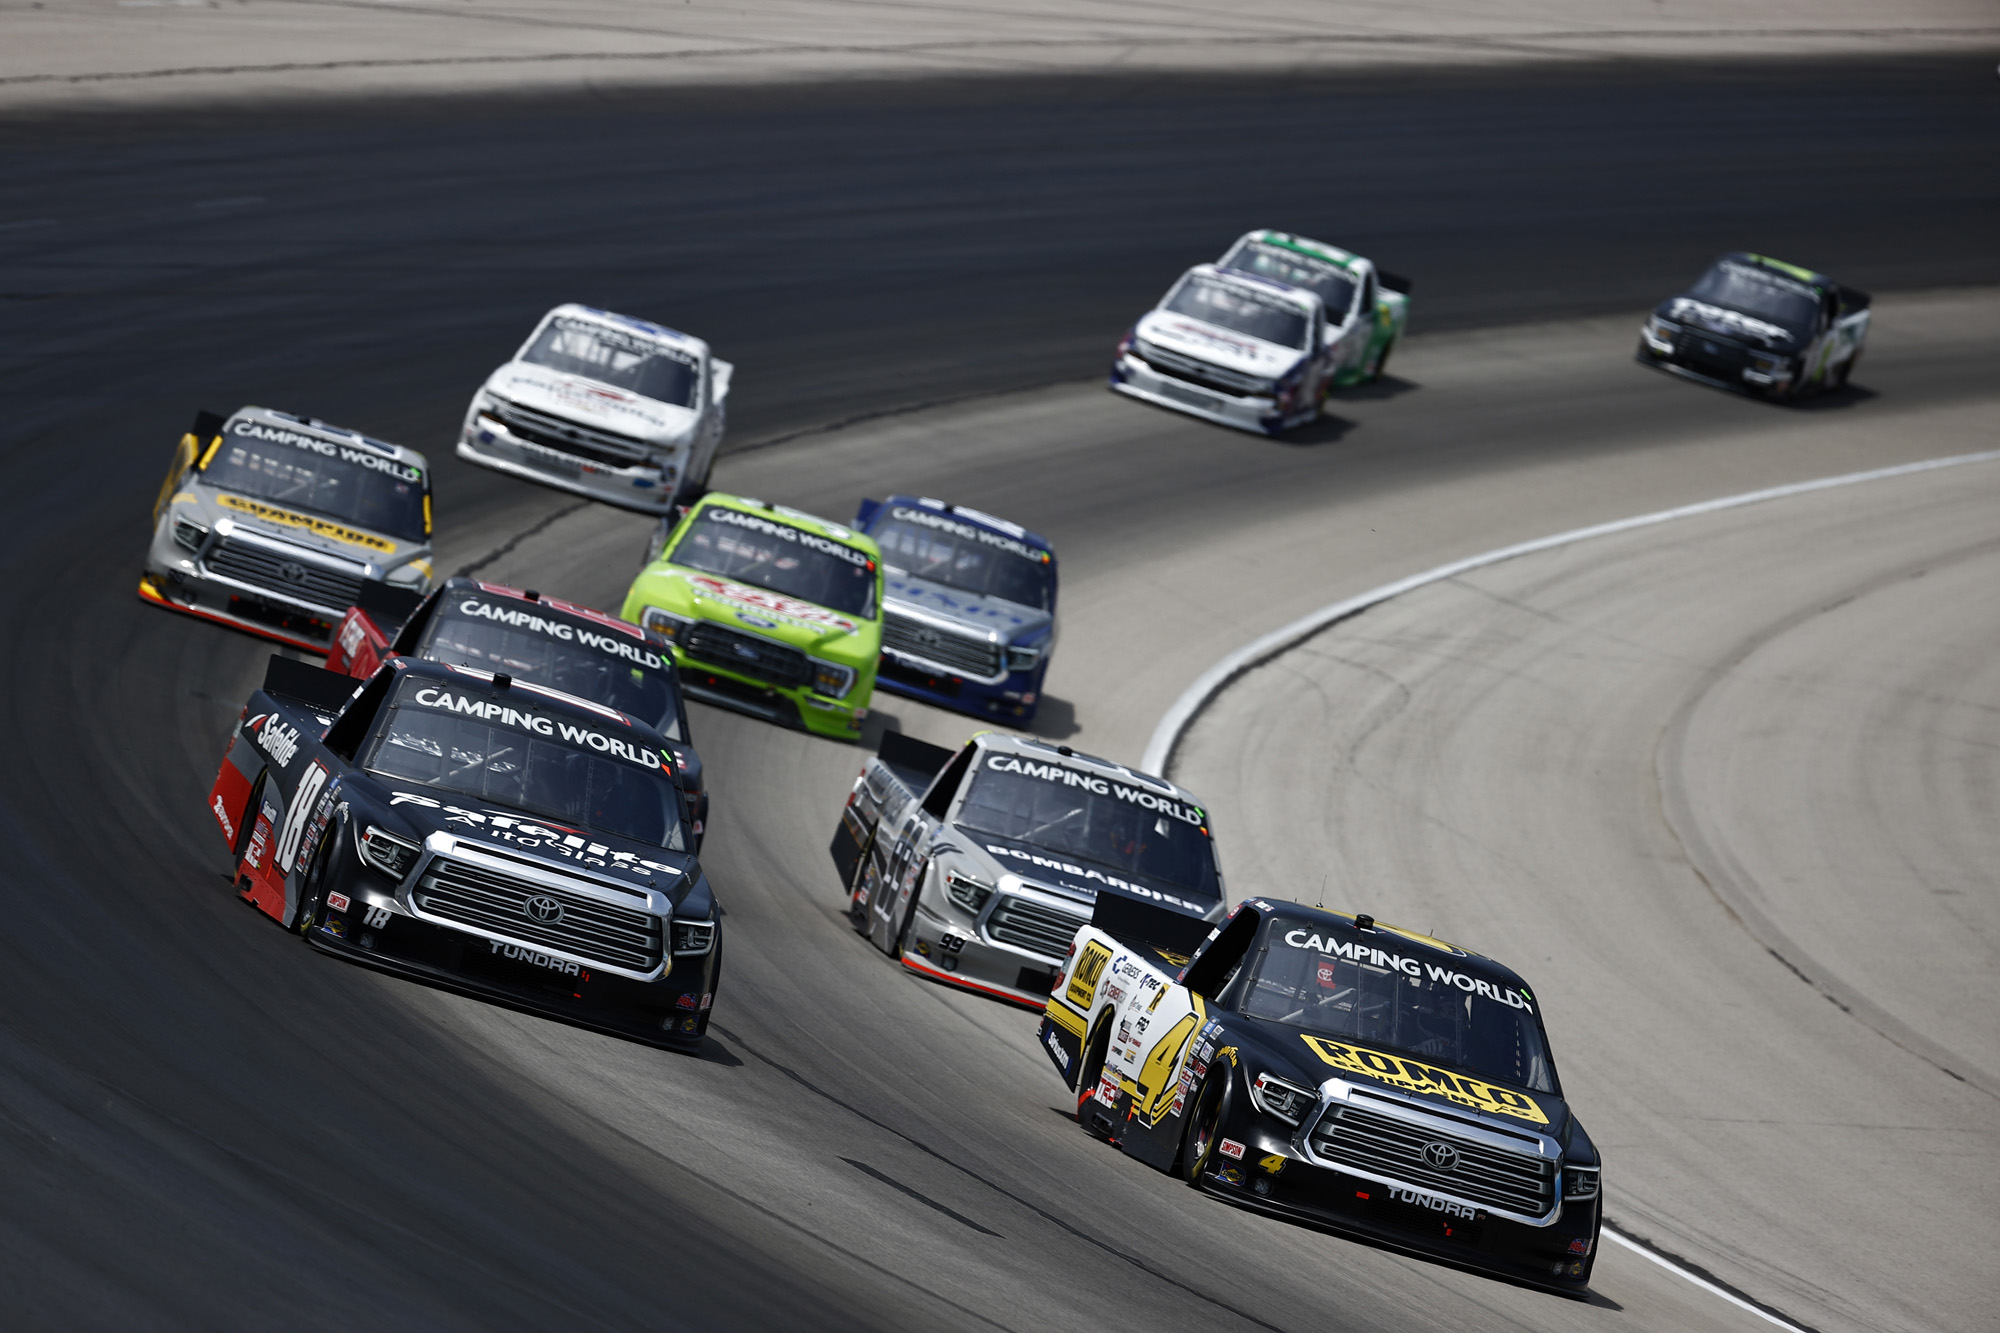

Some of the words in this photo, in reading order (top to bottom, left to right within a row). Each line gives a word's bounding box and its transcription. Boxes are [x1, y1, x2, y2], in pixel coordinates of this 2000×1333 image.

[233, 422, 337, 456] CAMPING
[340, 449, 418, 482] WORLD
[226, 496, 388, 549] CHAMPION
[708, 508, 798, 542] CAMPING
[799, 530, 867, 567] WORLD
[892, 507, 976, 540] CAMPING
[978, 530, 1043, 562] WORLD
[459, 600, 573, 641] CAMPING
[576, 627, 662, 670] WORLD
[257, 712, 301, 768] Safelite
[415, 688, 554, 737] CAMPING
[557, 721, 662, 770] WORLD
[987, 755, 1111, 796] CAMPING
[1113, 783, 1202, 826] WORLD
[389, 790, 683, 876] Safelite
[986, 844, 1206, 914] BOMBARDIER
[362, 905, 393, 930] 18
[938, 932, 966, 953] 99
[489, 940, 580, 977] TUNDRA
[1284, 929, 1421, 977] CAMPING
[1424, 962, 1524, 1010] WORLD
[1135, 1012, 1200, 1130] 4
[1313, 1037, 1533, 1111] ROMCO
[1221, 1141, 1243, 1157] SIMPSON
[1259, 1154, 1287, 1176] 4
[1387, 1185, 1477, 1222] TUNDRA
